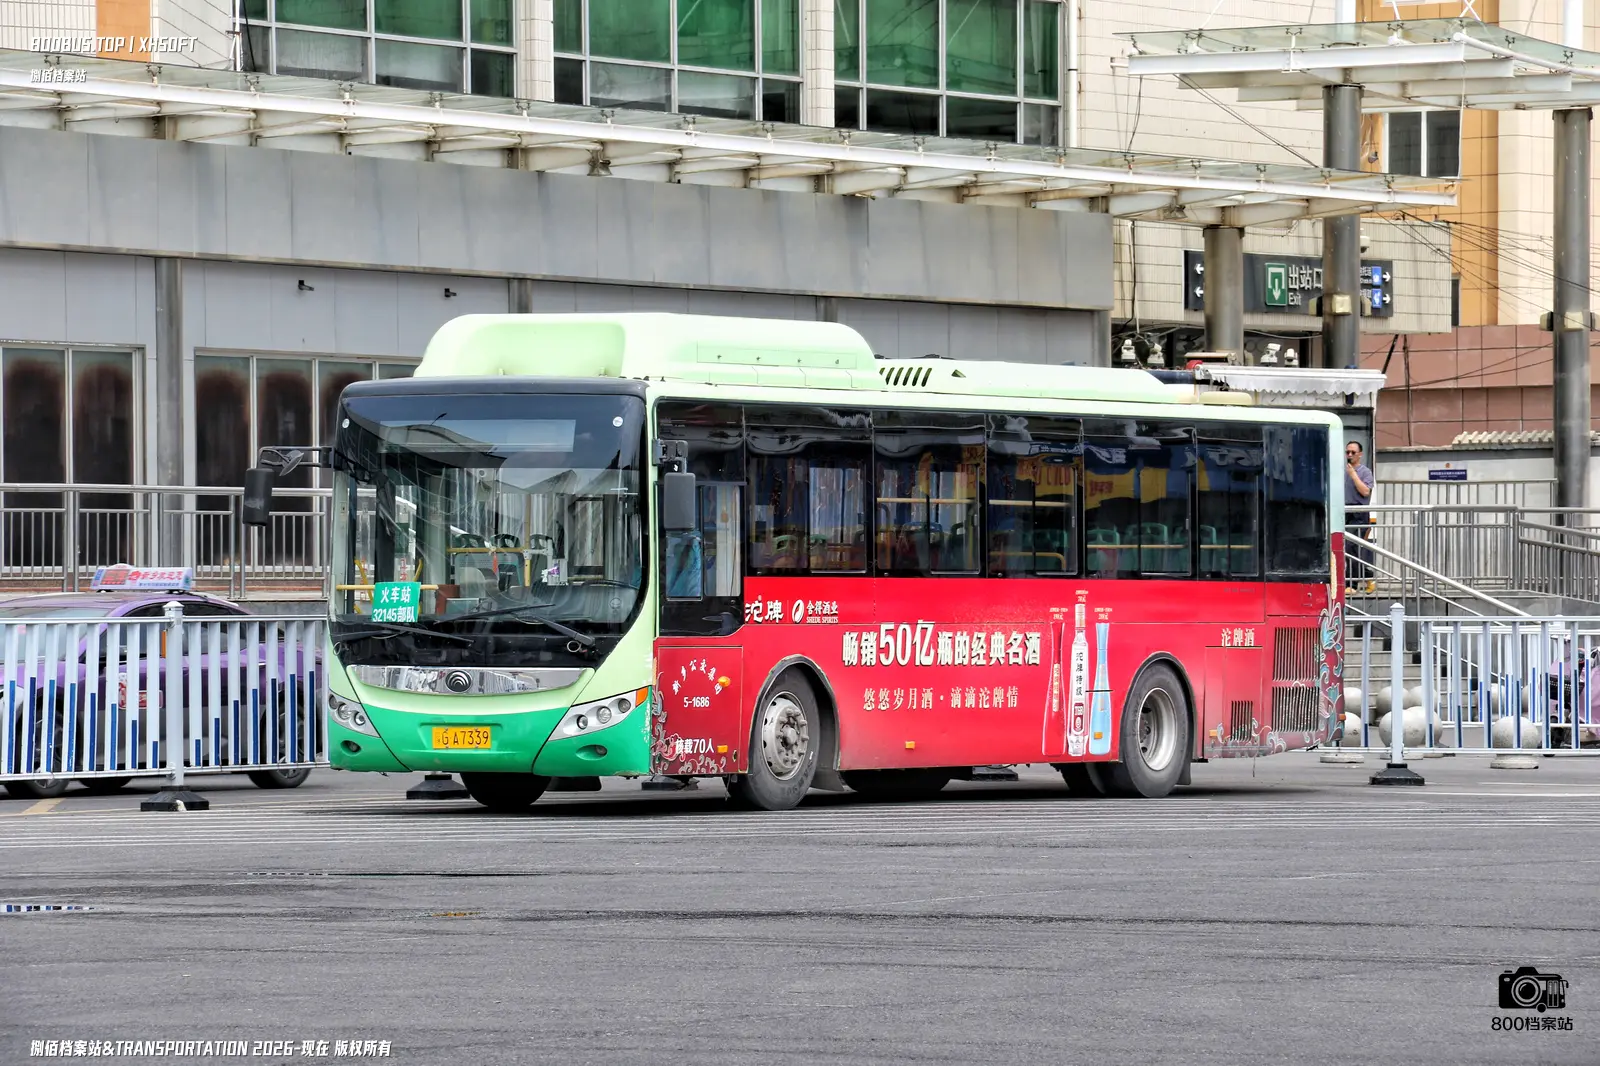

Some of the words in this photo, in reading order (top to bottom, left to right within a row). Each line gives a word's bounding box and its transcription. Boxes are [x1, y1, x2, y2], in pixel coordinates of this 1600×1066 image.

[1288, 264, 1323, 290] 出站口
[1288, 292, 1302, 306] Exit
[380, 586, 412, 604] 火车站
[372, 606, 415, 622] 32145部队
[745, 599, 784, 623] 沱牌
[806, 600, 839, 615] 舍得酒业
[842, 619, 1042, 667] 畅销50亿瓶的经典名酒
[1221, 628, 1255, 647] 沱牌酒
[683, 696, 710, 708] 5-1686
[434, 730, 489, 746] GA7339
[675, 738, 715, 755] 核载70人
